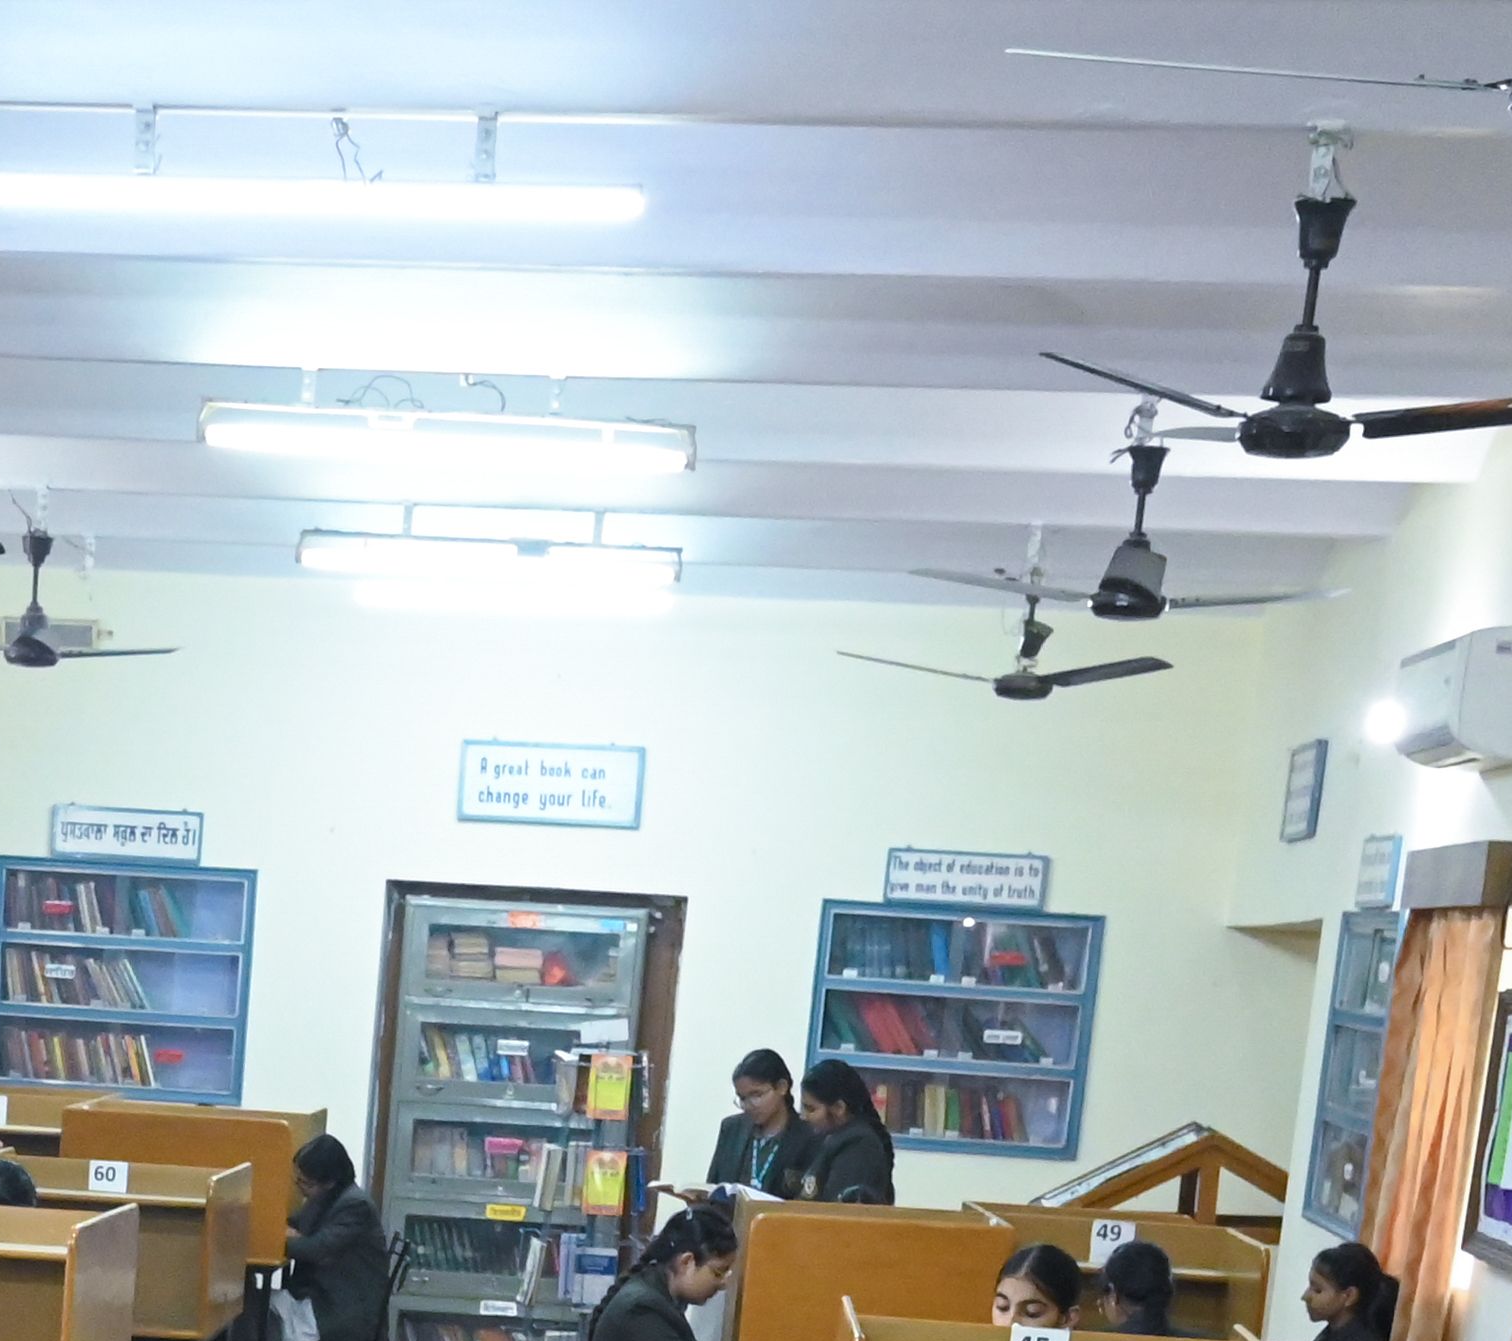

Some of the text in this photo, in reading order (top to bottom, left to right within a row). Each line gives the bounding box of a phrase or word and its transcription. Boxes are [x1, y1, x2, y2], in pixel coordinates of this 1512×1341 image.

[480, 757, 606, 780] A great book can
[478, 786, 529, 809] change
[539, 793, 573, 811] your
[893, 855, 1040, 878] The object of education is to
[915, 882, 936, 895] man
[941, 881, 957, 895] the
[961, 883, 988, 900] unity
[993, 884, 1004, 899] of
[93, 1165, 116, 1182] 60
[1096, 1223, 1122, 1242] 49
